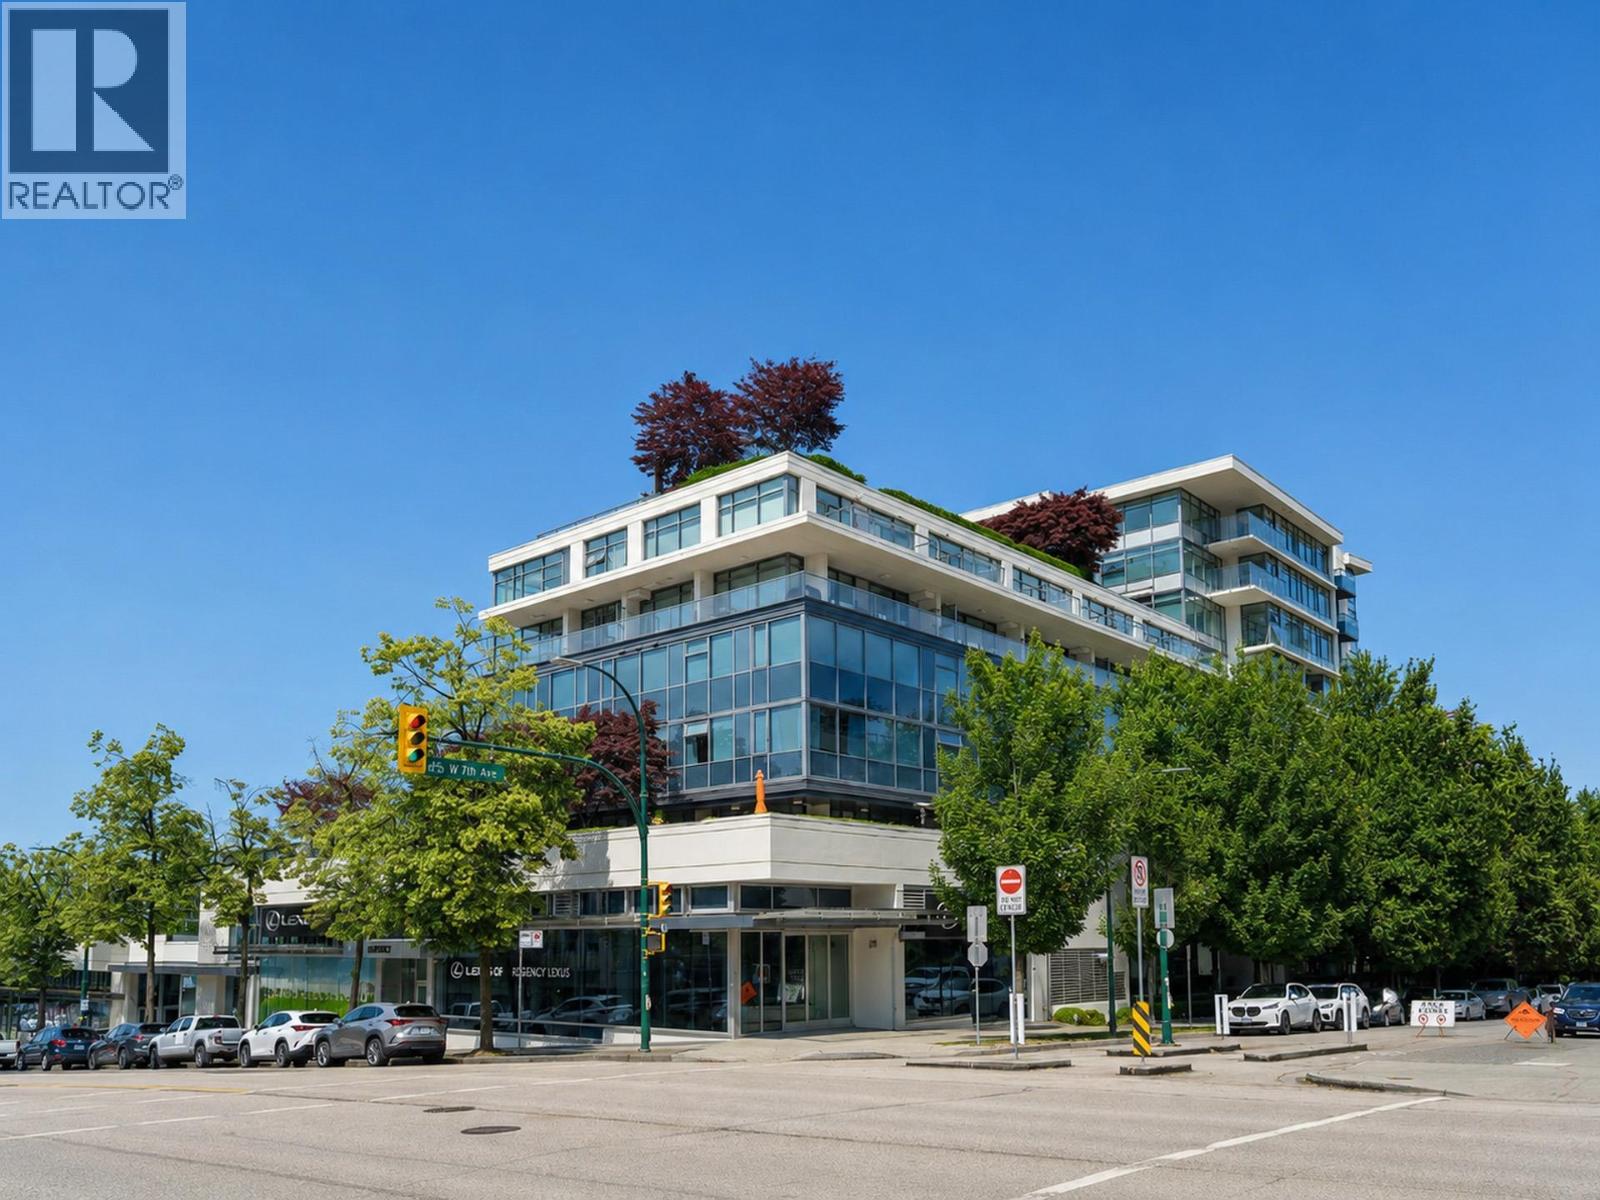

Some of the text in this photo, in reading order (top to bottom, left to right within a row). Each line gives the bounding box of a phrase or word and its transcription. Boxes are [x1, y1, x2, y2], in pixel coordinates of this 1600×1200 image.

[449, 763, 460, 775] W
[281, 914, 309, 926] LEX
[547, 967, 571, 978] LEXUS
